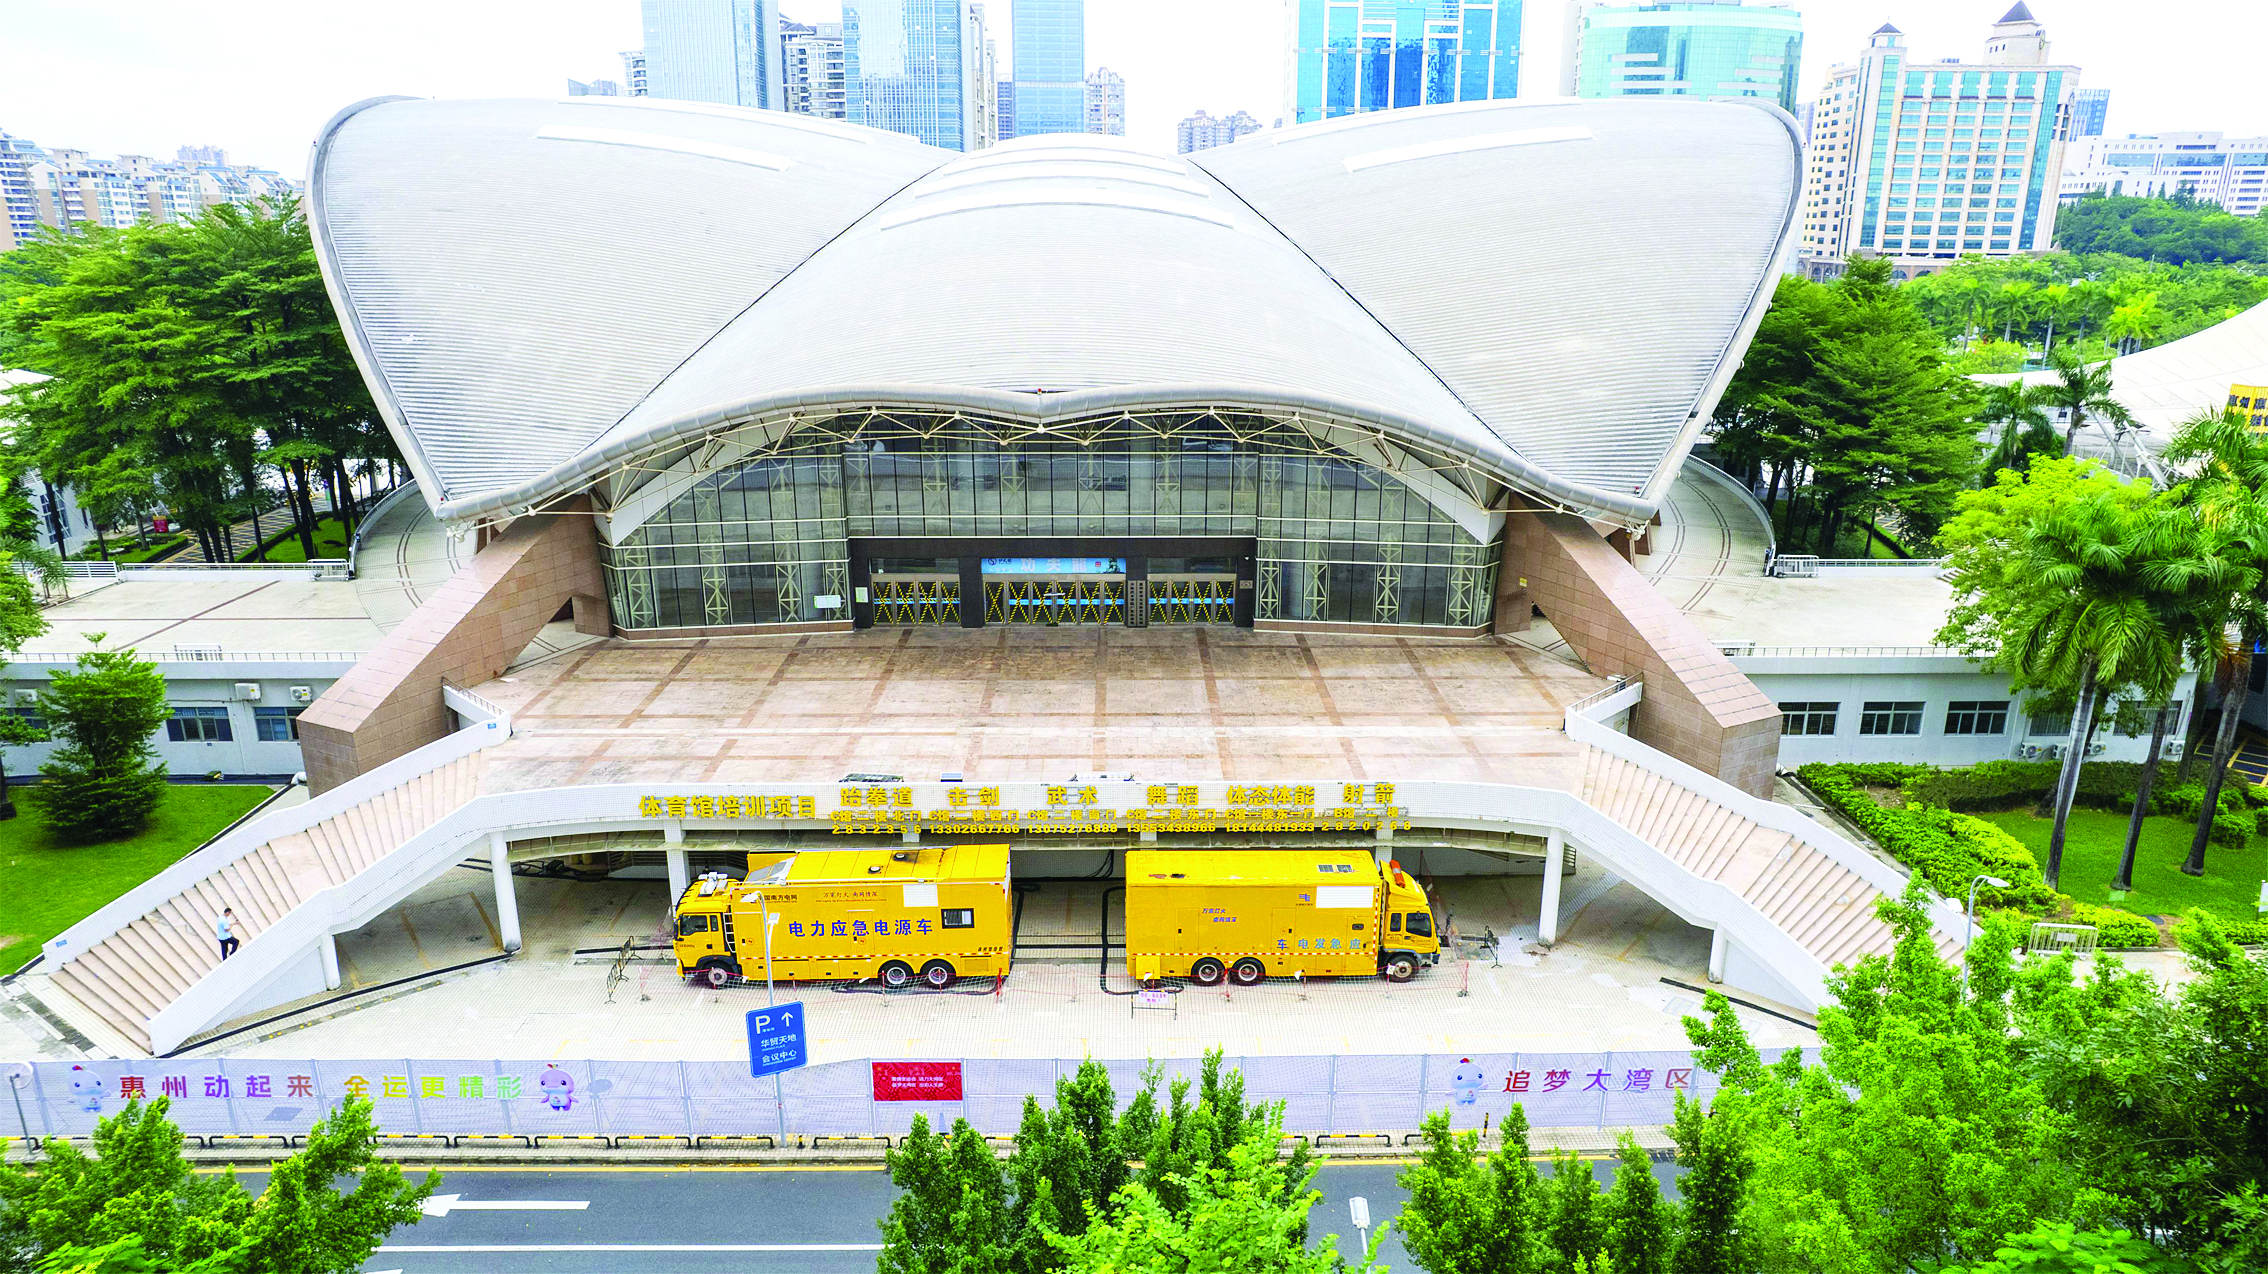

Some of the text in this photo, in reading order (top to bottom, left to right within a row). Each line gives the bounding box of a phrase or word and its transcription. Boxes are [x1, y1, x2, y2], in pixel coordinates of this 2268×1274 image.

[840, 786, 914, 808] 跆拳道
[947, 785, 1000, 806] 击剑
[1046, 785, 1099, 806] 武术
[1146, 785, 1199, 806] 舞蹈
[1225, 785, 1316, 806] 体态体能
[1343, 783, 1396, 804] 射箭
[638, 795, 816, 818] 体育馆培训项目
[832, 824, 922, 834] 2832356
[929, 824, 1020, 834] 13302667766
[1028, 823, 1118, 833] 13075276888
[1126, 823, 1216, 833] 13553438966
[1225, 822, 1315, 832] 18144481933
[1321, 821, 1411, 831] 2820268
[789, 918, 933, 937] 电力应急电源车
[755, 1014, 771, 1034] P
[760, 1033, 797, 1048] 华贸天地
[762, 1049, 797, 1064] 会议中心
[119, 1075, 522, 1099] 惠州动起来 全运更精彩
[1503, 1068, 1693, 1093] 追梦大湾区
